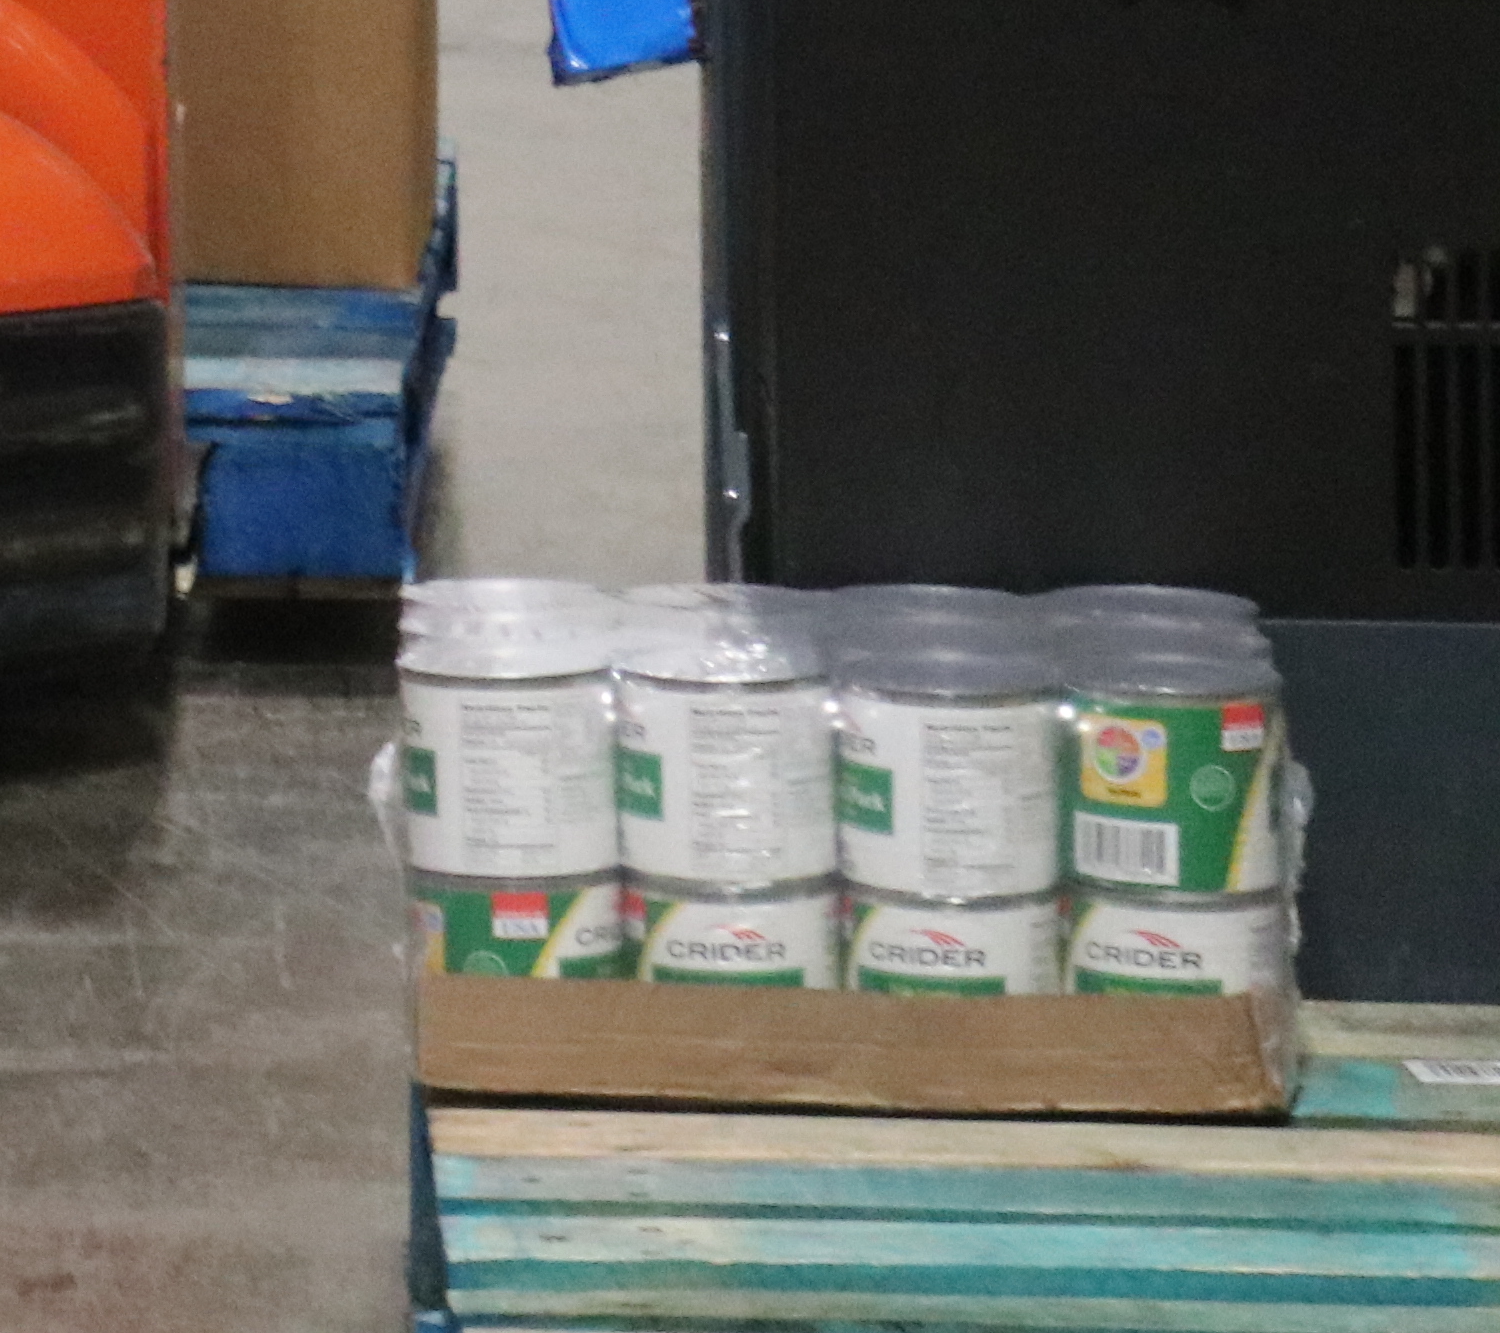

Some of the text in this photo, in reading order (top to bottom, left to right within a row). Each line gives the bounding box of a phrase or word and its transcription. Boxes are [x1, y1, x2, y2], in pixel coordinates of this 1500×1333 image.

[667, 940, 787, 962] CRIDER
[871, 941, 987, 968] CRIDER
[1086, 941, 1202, 970] CRIDER
